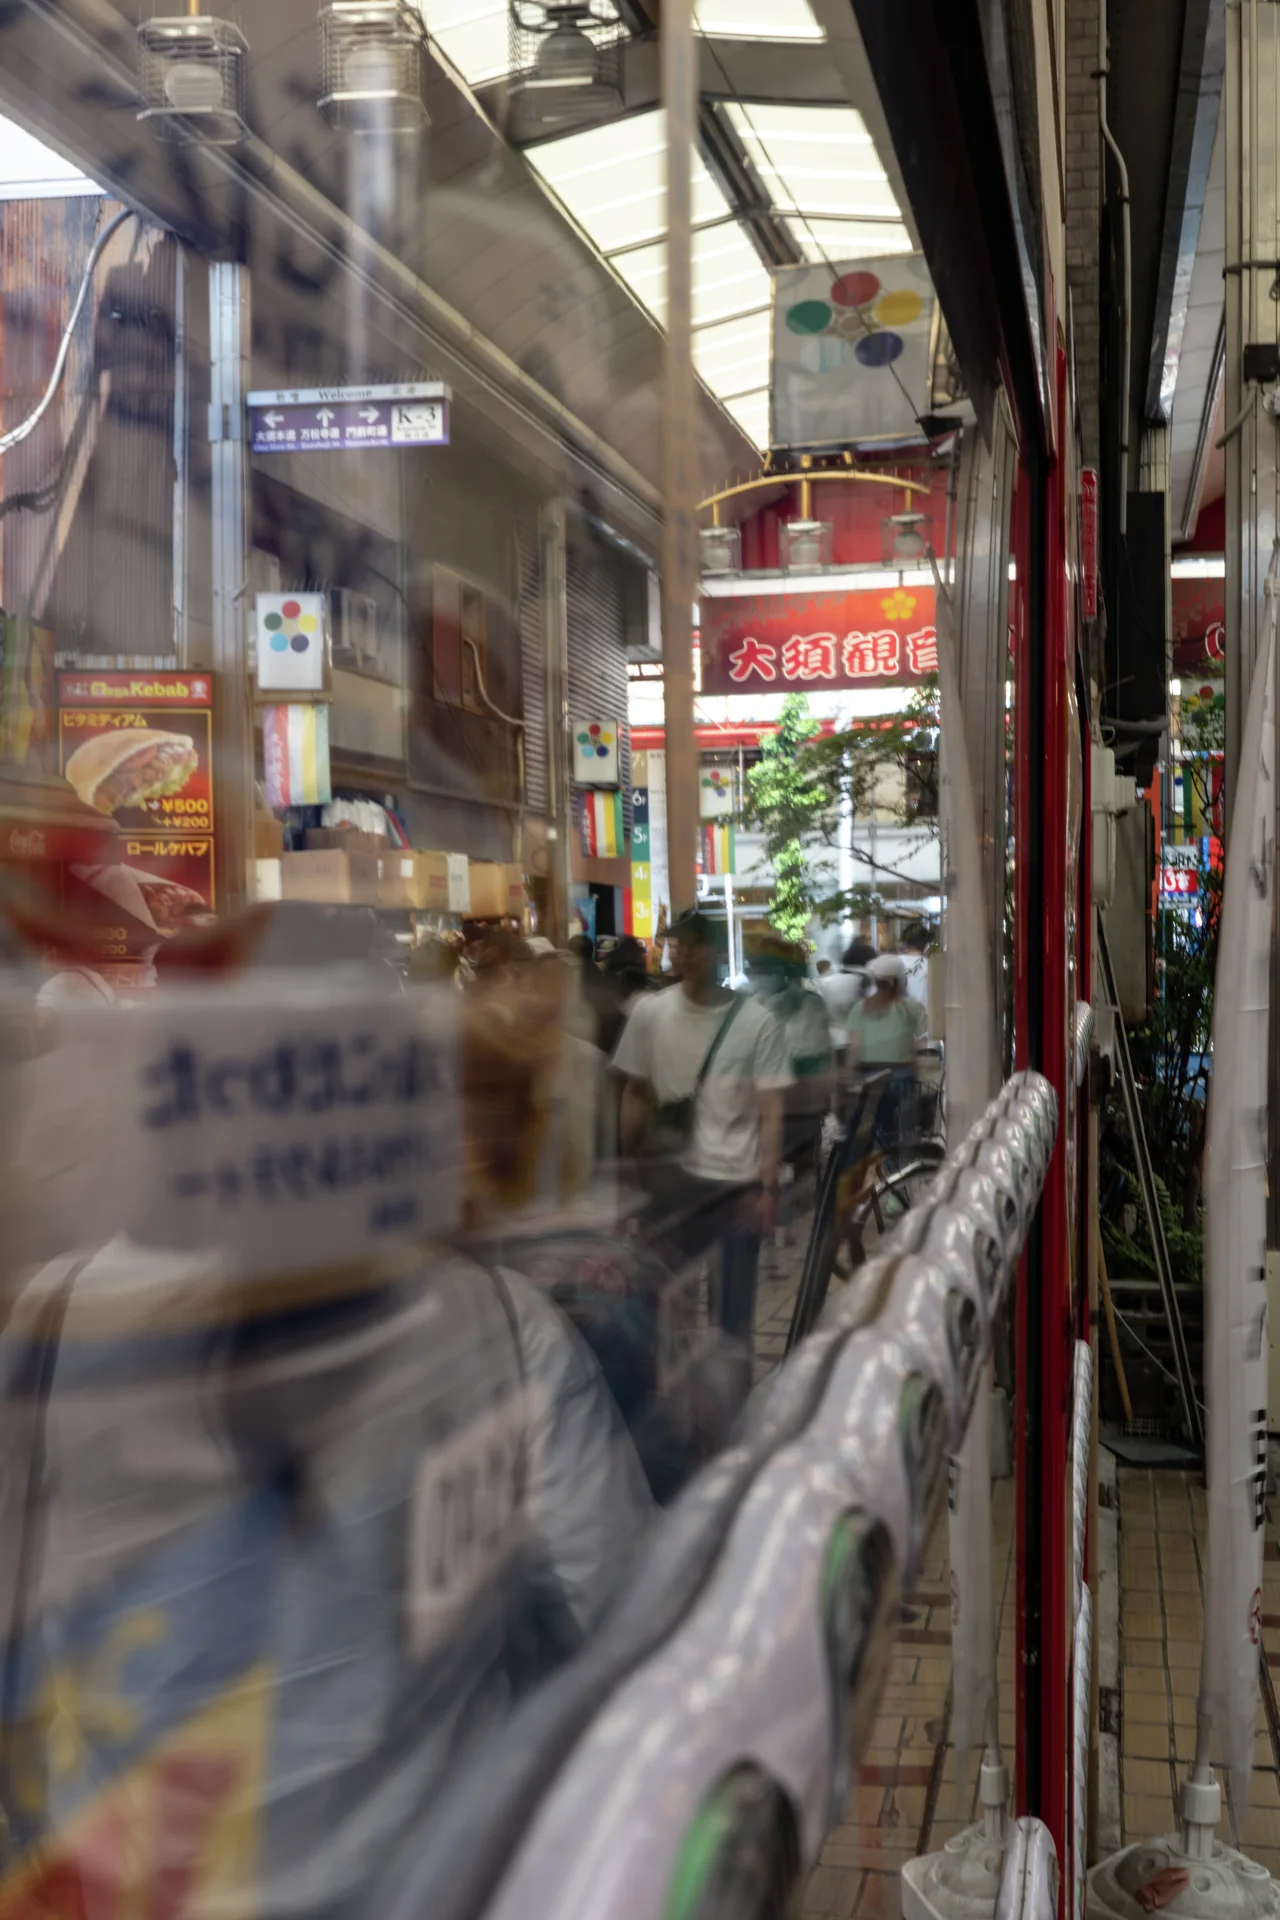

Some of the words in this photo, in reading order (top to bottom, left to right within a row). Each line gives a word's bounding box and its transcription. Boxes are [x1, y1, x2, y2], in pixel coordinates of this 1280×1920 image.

[318, 388, 372, 401] Welcome
[398, 404, 437, 424] K-3
[130, 681, 189, 697] Kebab
[162, 798, 209, 814] ¥500
